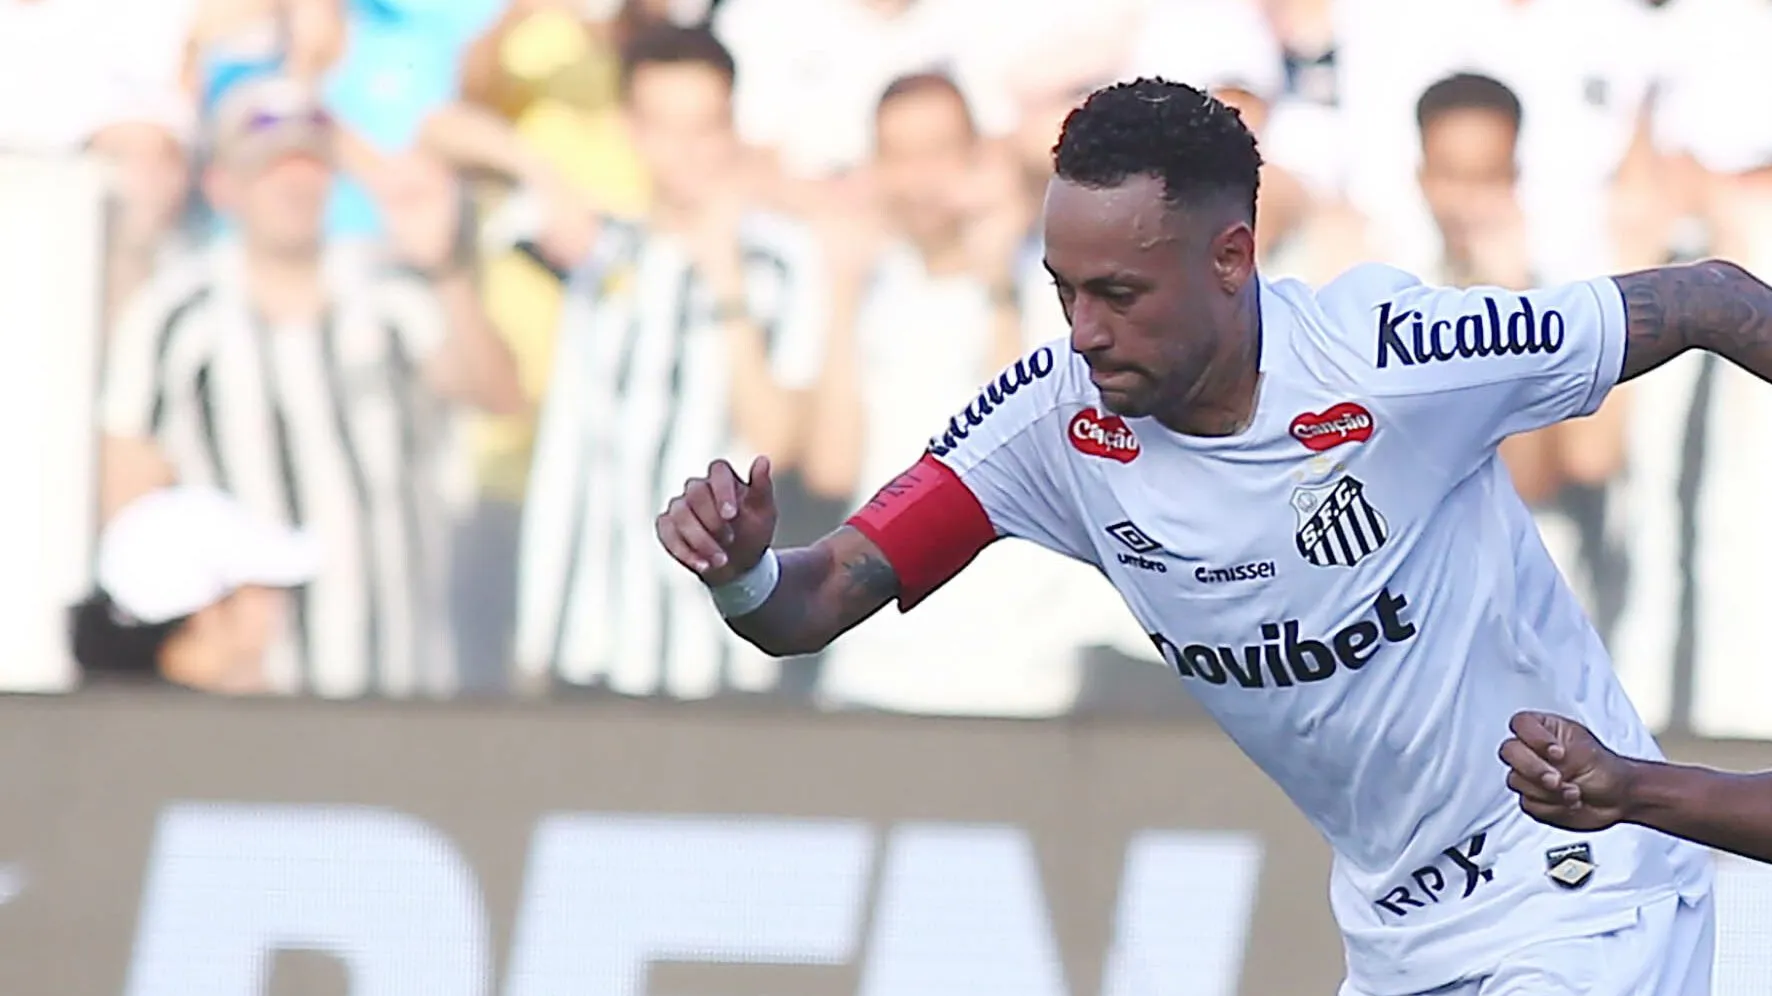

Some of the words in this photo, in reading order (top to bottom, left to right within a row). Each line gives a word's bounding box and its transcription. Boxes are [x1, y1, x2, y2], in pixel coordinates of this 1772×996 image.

[1372, 296, 1564, 368] Kicaldo
[1293, 412, 1370, 438] Canção
[1117, 552, 1168, 574] umbro
[1149, 587, 1416, 688] novibet
